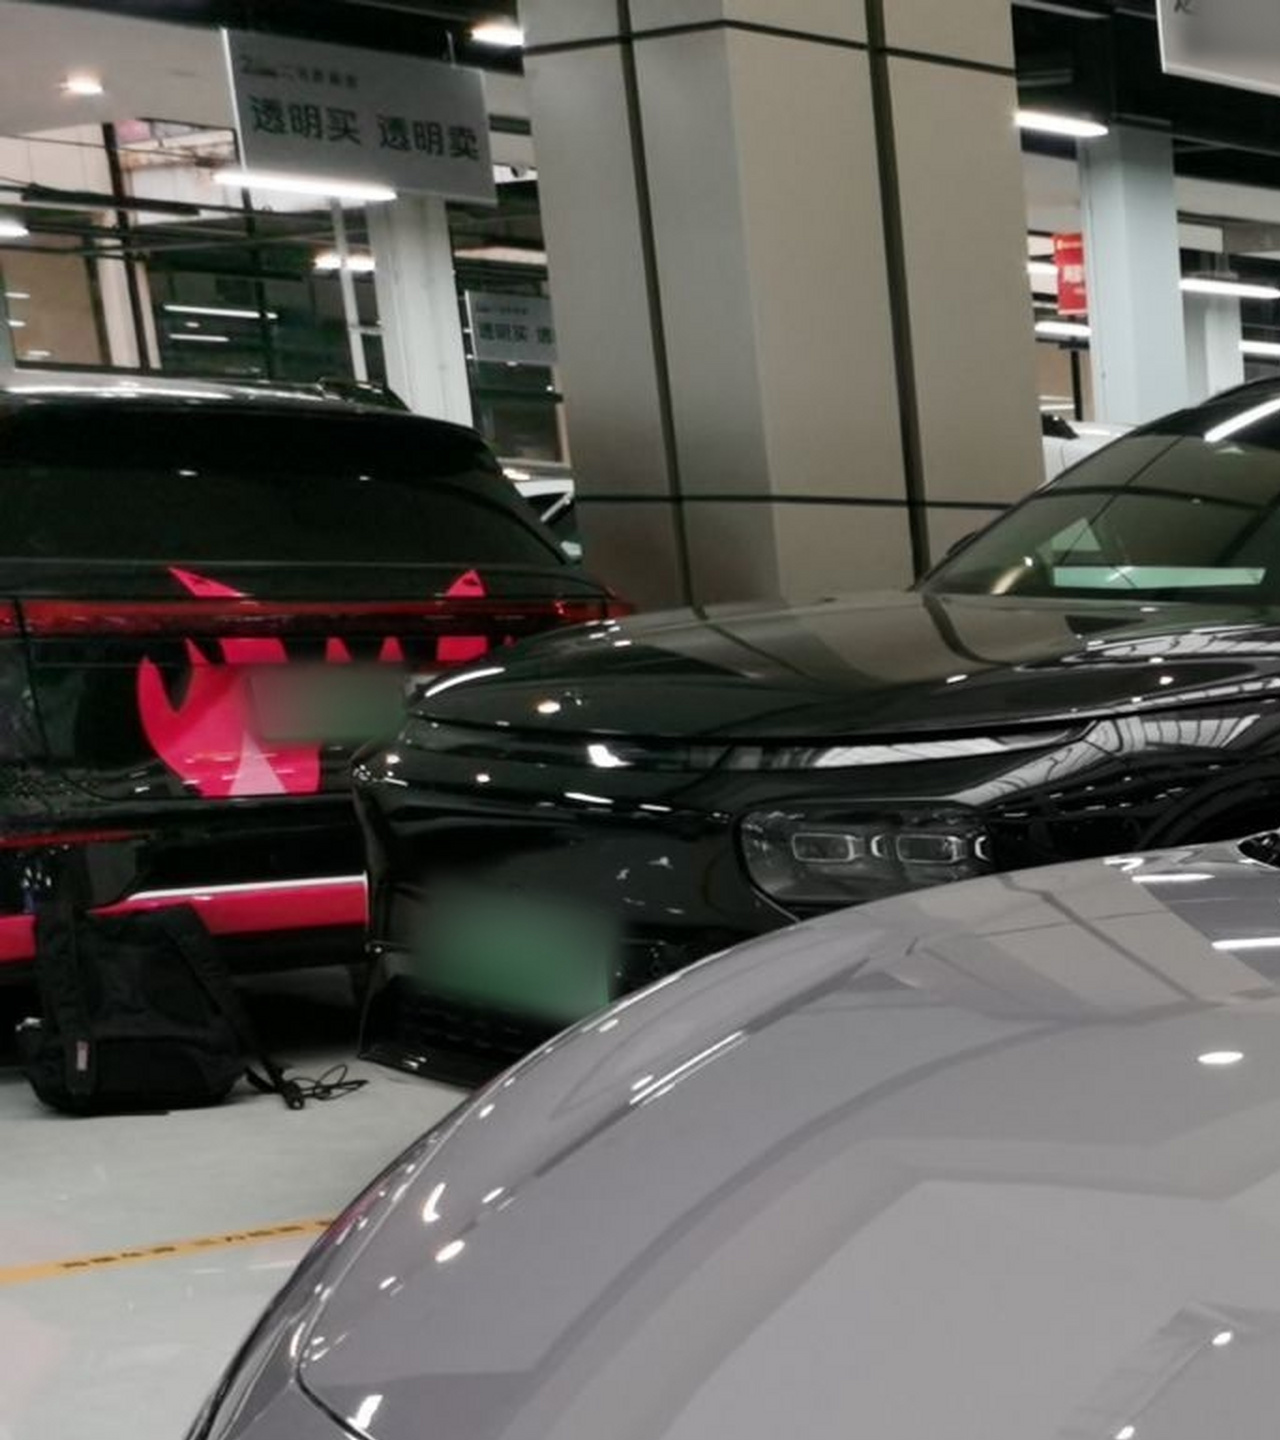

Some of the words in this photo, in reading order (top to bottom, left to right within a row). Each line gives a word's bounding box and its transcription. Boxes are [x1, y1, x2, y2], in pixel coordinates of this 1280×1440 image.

[250, 97, 361, 147] 透明买
[376, 113, 480, 160] 透明卖
